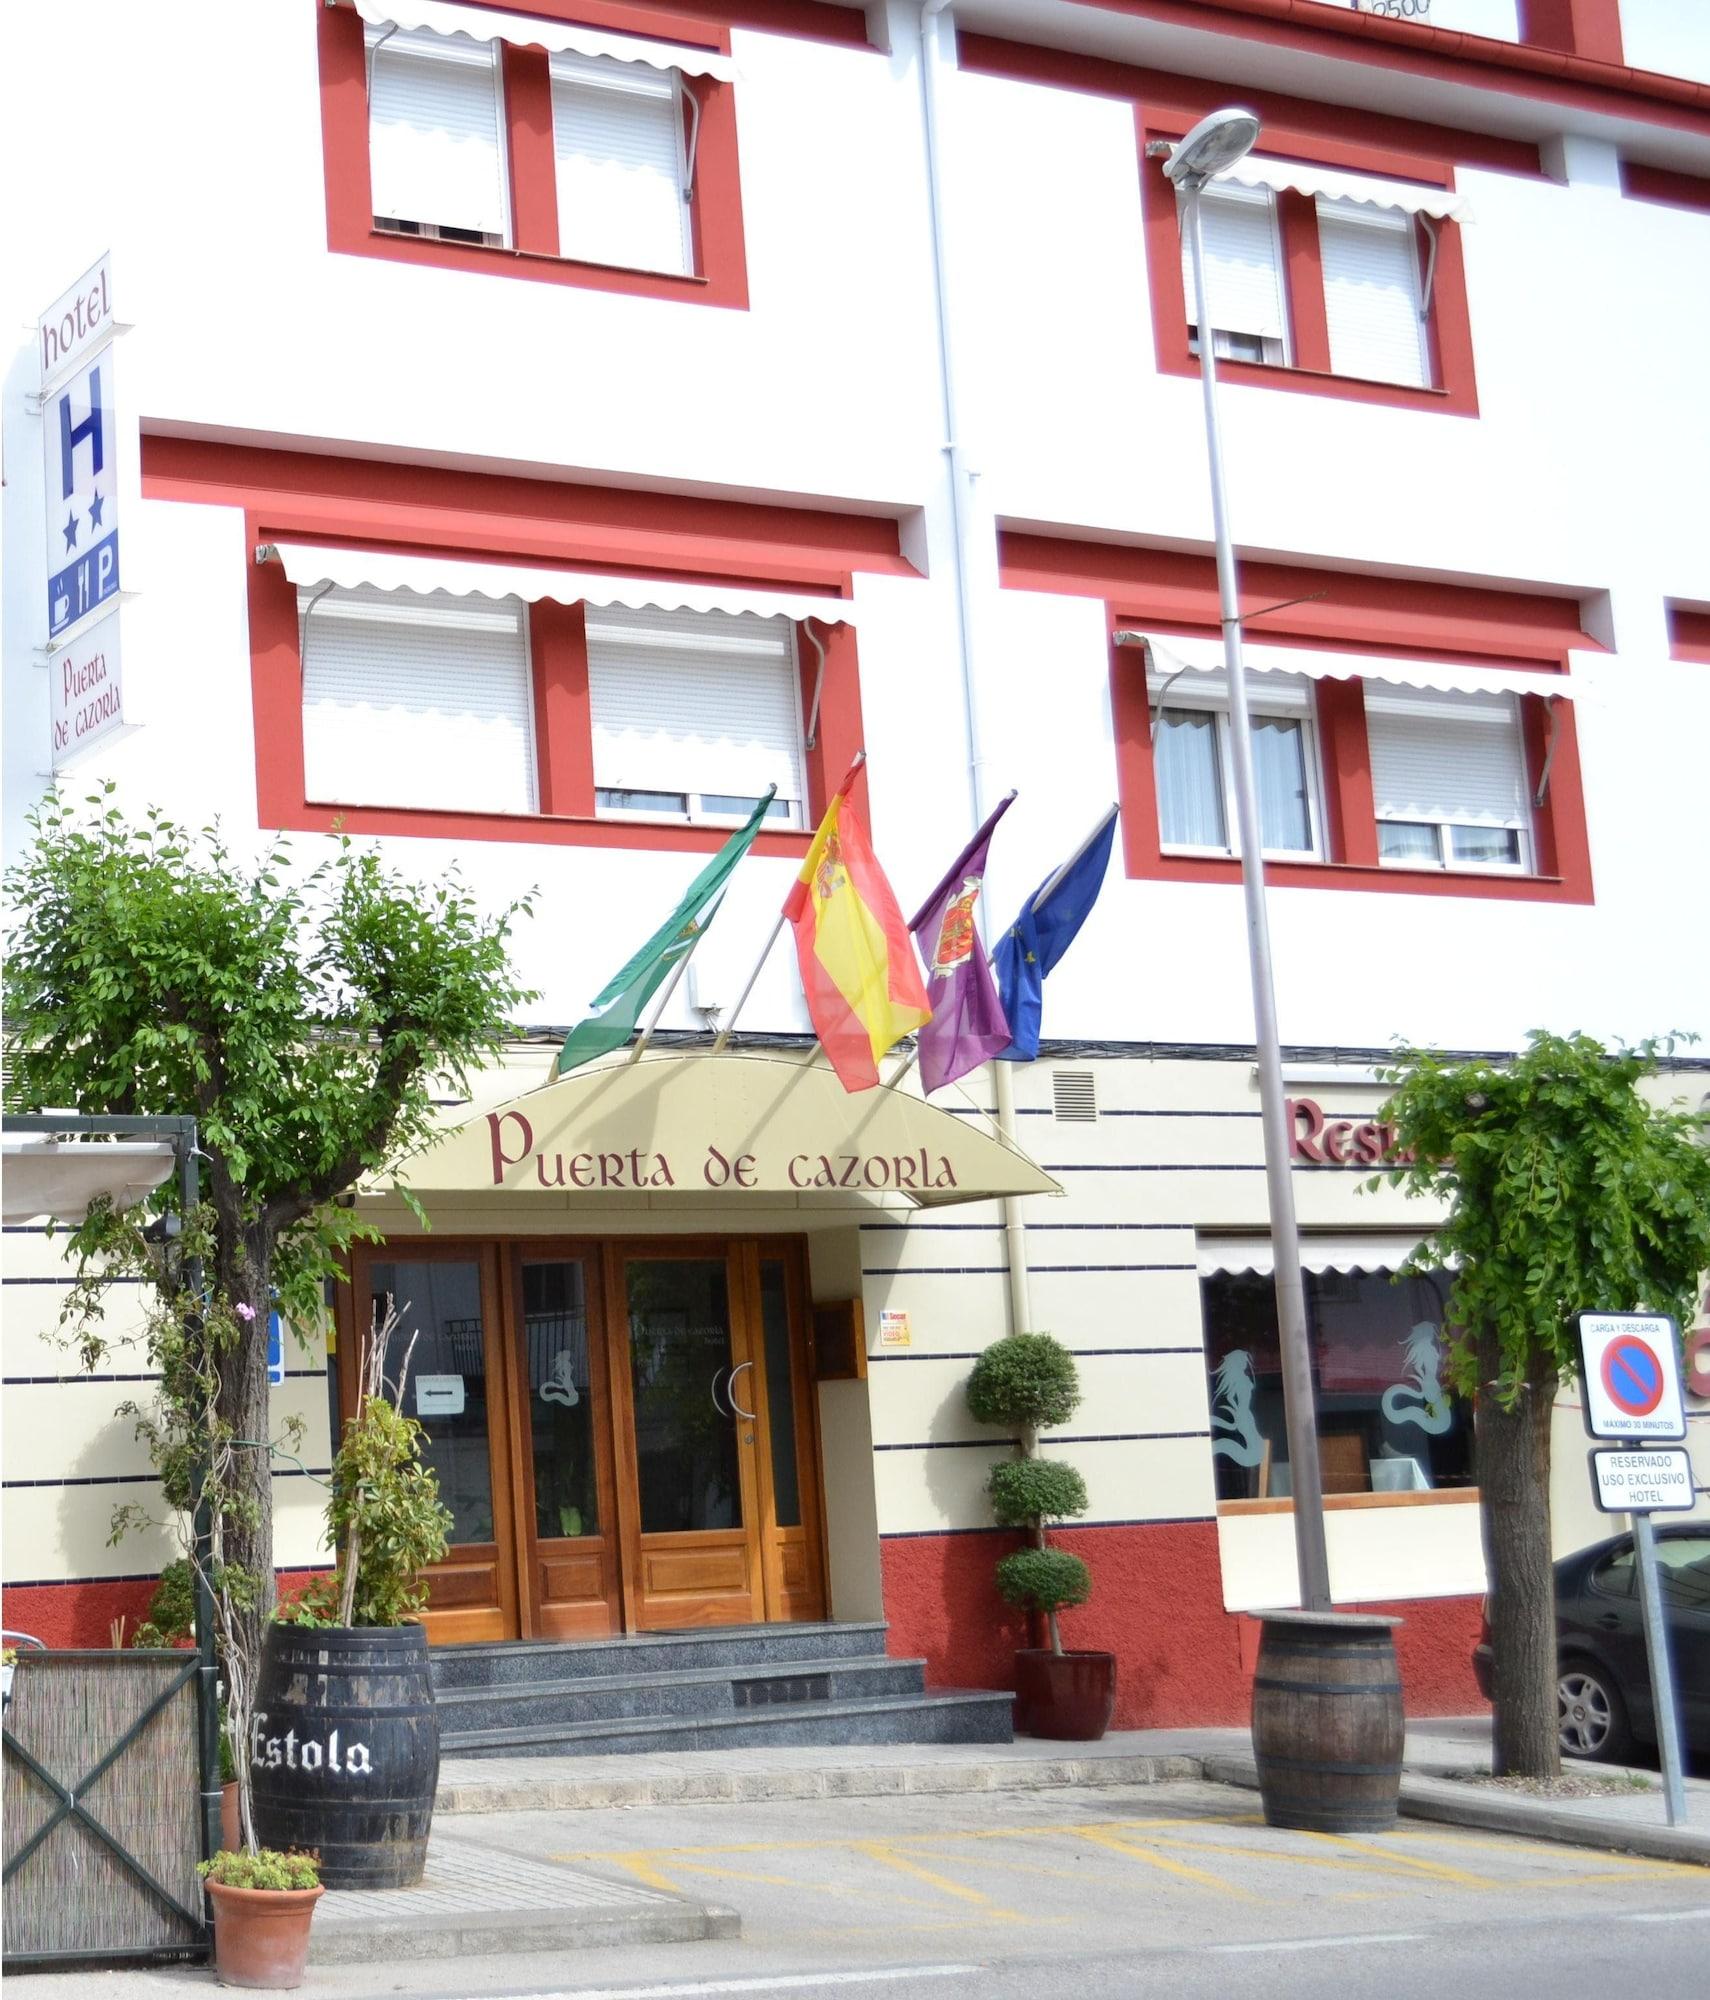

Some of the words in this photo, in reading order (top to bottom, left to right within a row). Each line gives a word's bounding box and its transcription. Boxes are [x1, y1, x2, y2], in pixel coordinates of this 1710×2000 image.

[42, 269, 110, 370] hotel
[60, 366, 103, 500] H
[62, 652, 108, 708] Puerta
[54, 716, 70, 752] de
[485, 1110, 676, 1188] Puerta
[703, 1144, 759, 1188] de
[788, 1147, 958, 1189] cazorla
[1590, 1323, 1615, 1333] CARGA
[1622, 1323, 1660, 1333] DESCARGA
[1642, 1421, 1674, 1430] MINUTOS
[1602, 1474, 1624, 1486] USO
[1628, 1472, 1685, 1486] EXCLUSIVO
[1610, 1456, 1672, 1468] RESERVADO
[1629, 1490, 1664, 1502] HOTEL
[251, 1712, 373, 1774] Estola
